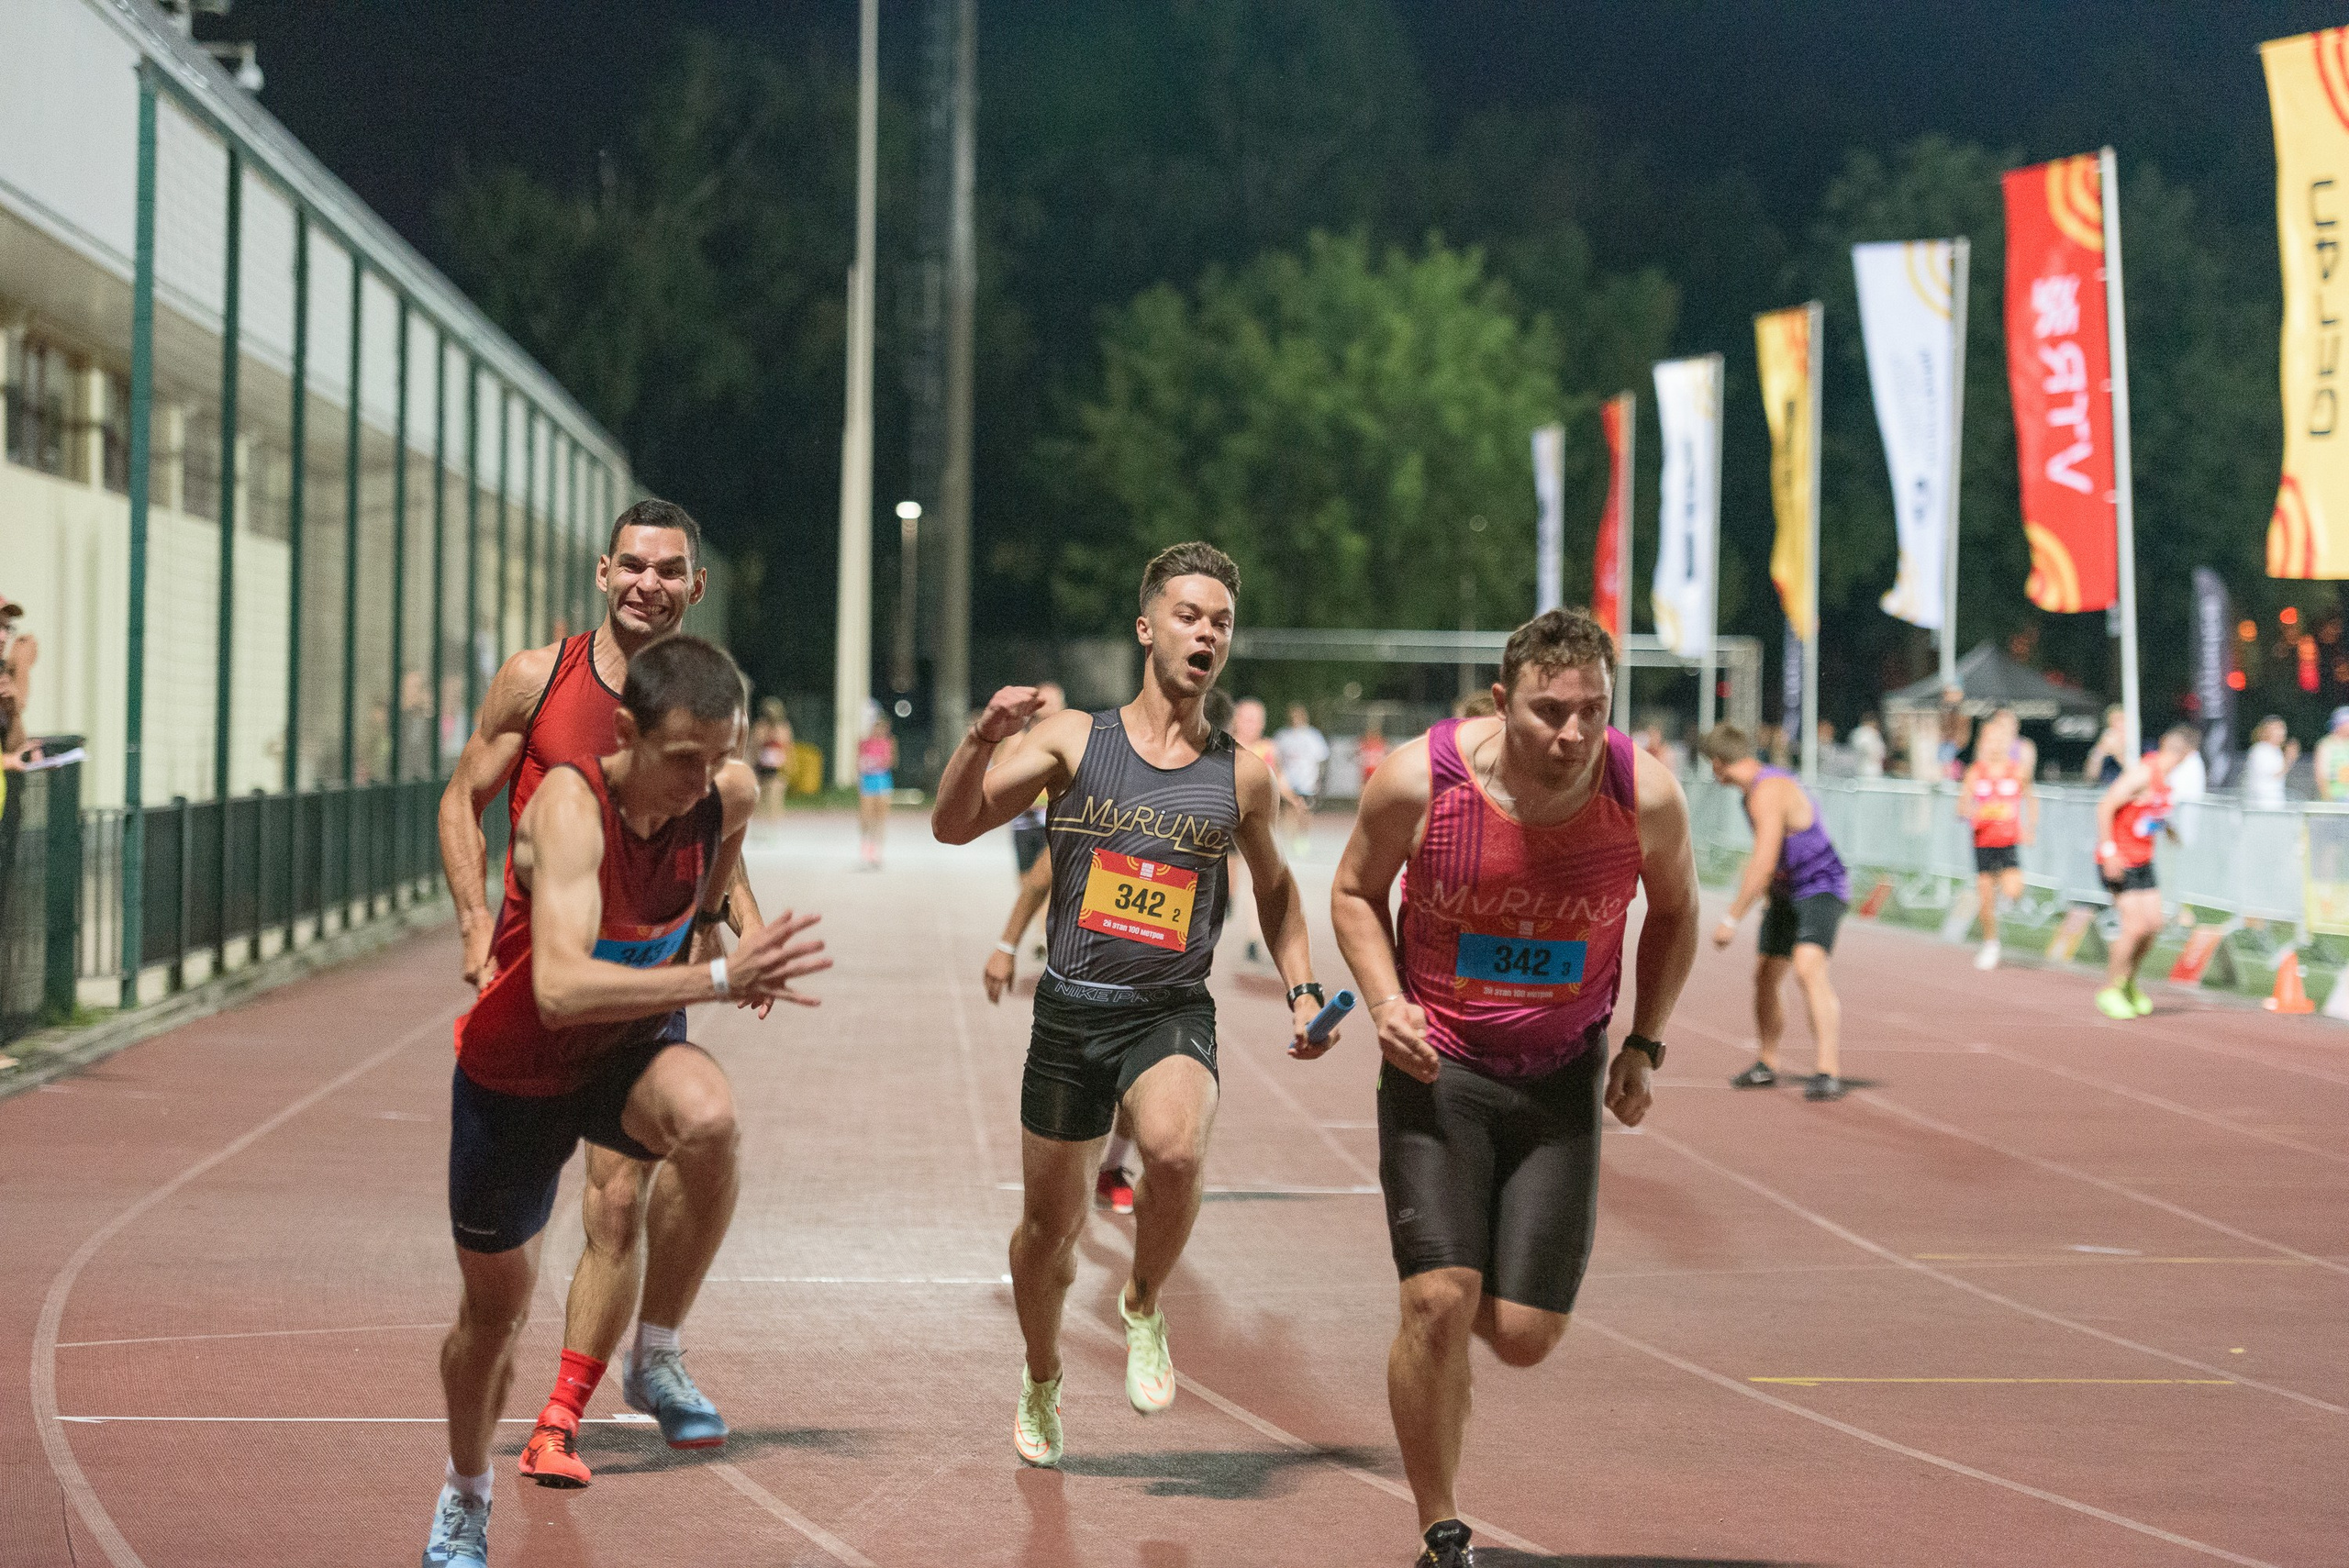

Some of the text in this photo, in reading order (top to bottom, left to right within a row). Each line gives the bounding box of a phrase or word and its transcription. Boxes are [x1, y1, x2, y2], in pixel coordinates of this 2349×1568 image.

[1115, 883, 1181, 923] 342 2
[1129, 925, 1141, 935] 100
[1494, 944, 1572, 977] 342 3
[1054, 981, 1113, 1003] NIKE
[1113, 988, 1171, 1004] PRO
